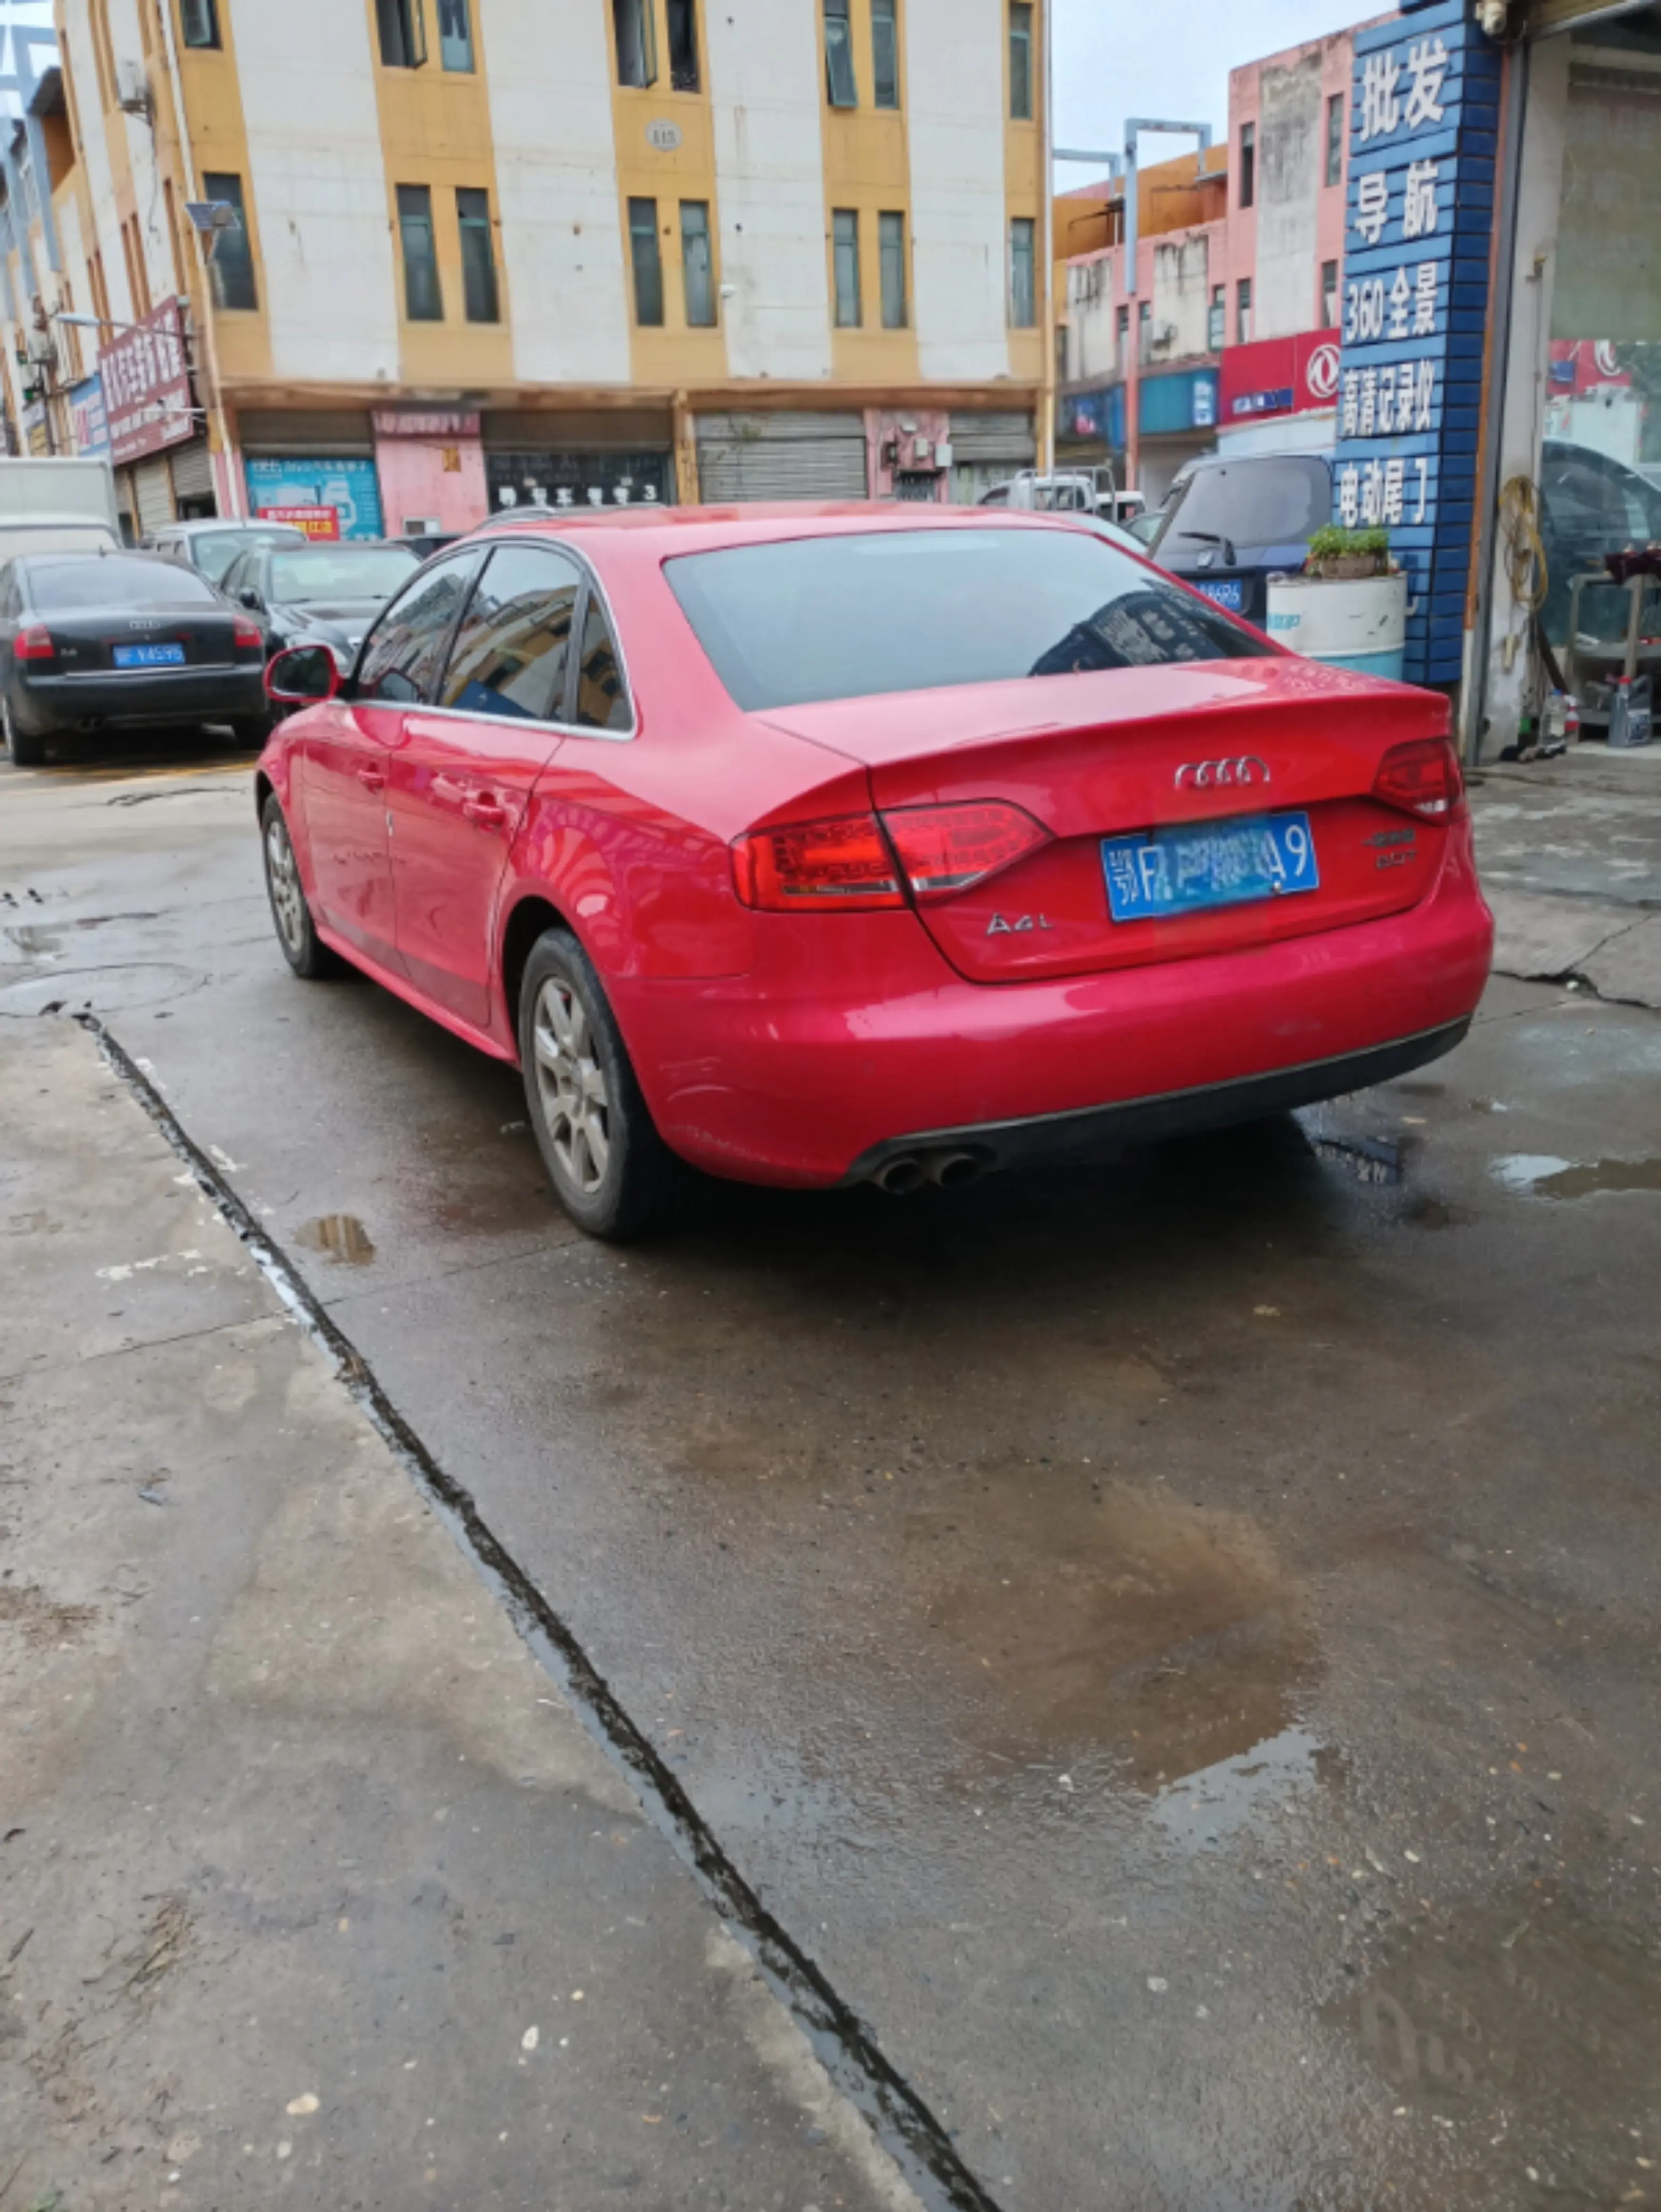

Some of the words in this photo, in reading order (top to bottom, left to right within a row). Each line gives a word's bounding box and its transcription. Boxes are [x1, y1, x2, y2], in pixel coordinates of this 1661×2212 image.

[1360, 38, 1448, 142] 批发
[1355, 159, 1438, 244] 导航
[1346, 262, 1437, 342] 360全景
